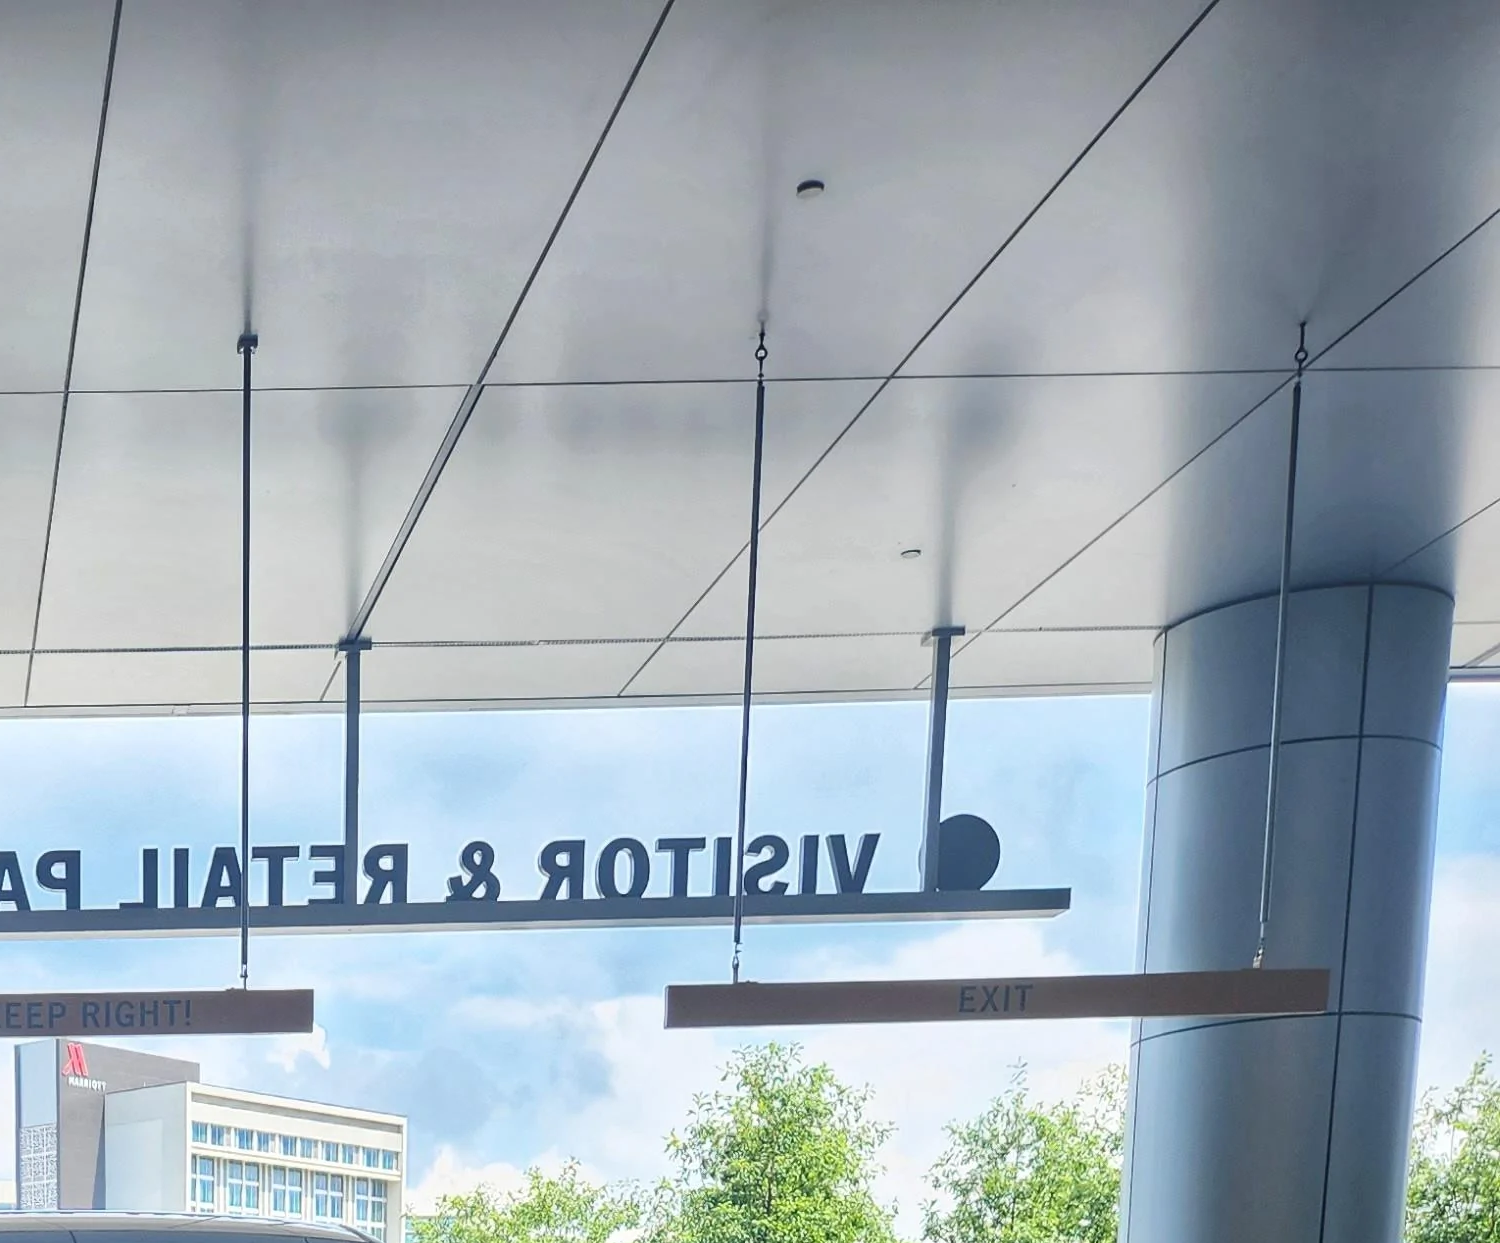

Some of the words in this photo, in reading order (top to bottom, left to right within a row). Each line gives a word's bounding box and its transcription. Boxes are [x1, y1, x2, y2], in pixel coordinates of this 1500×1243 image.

[958, 984, 1034, 1013] EXIT
[81, 1000, 191, 1028] RIGHT!
[68, 1076, 107, 1091] MARRIOTT
